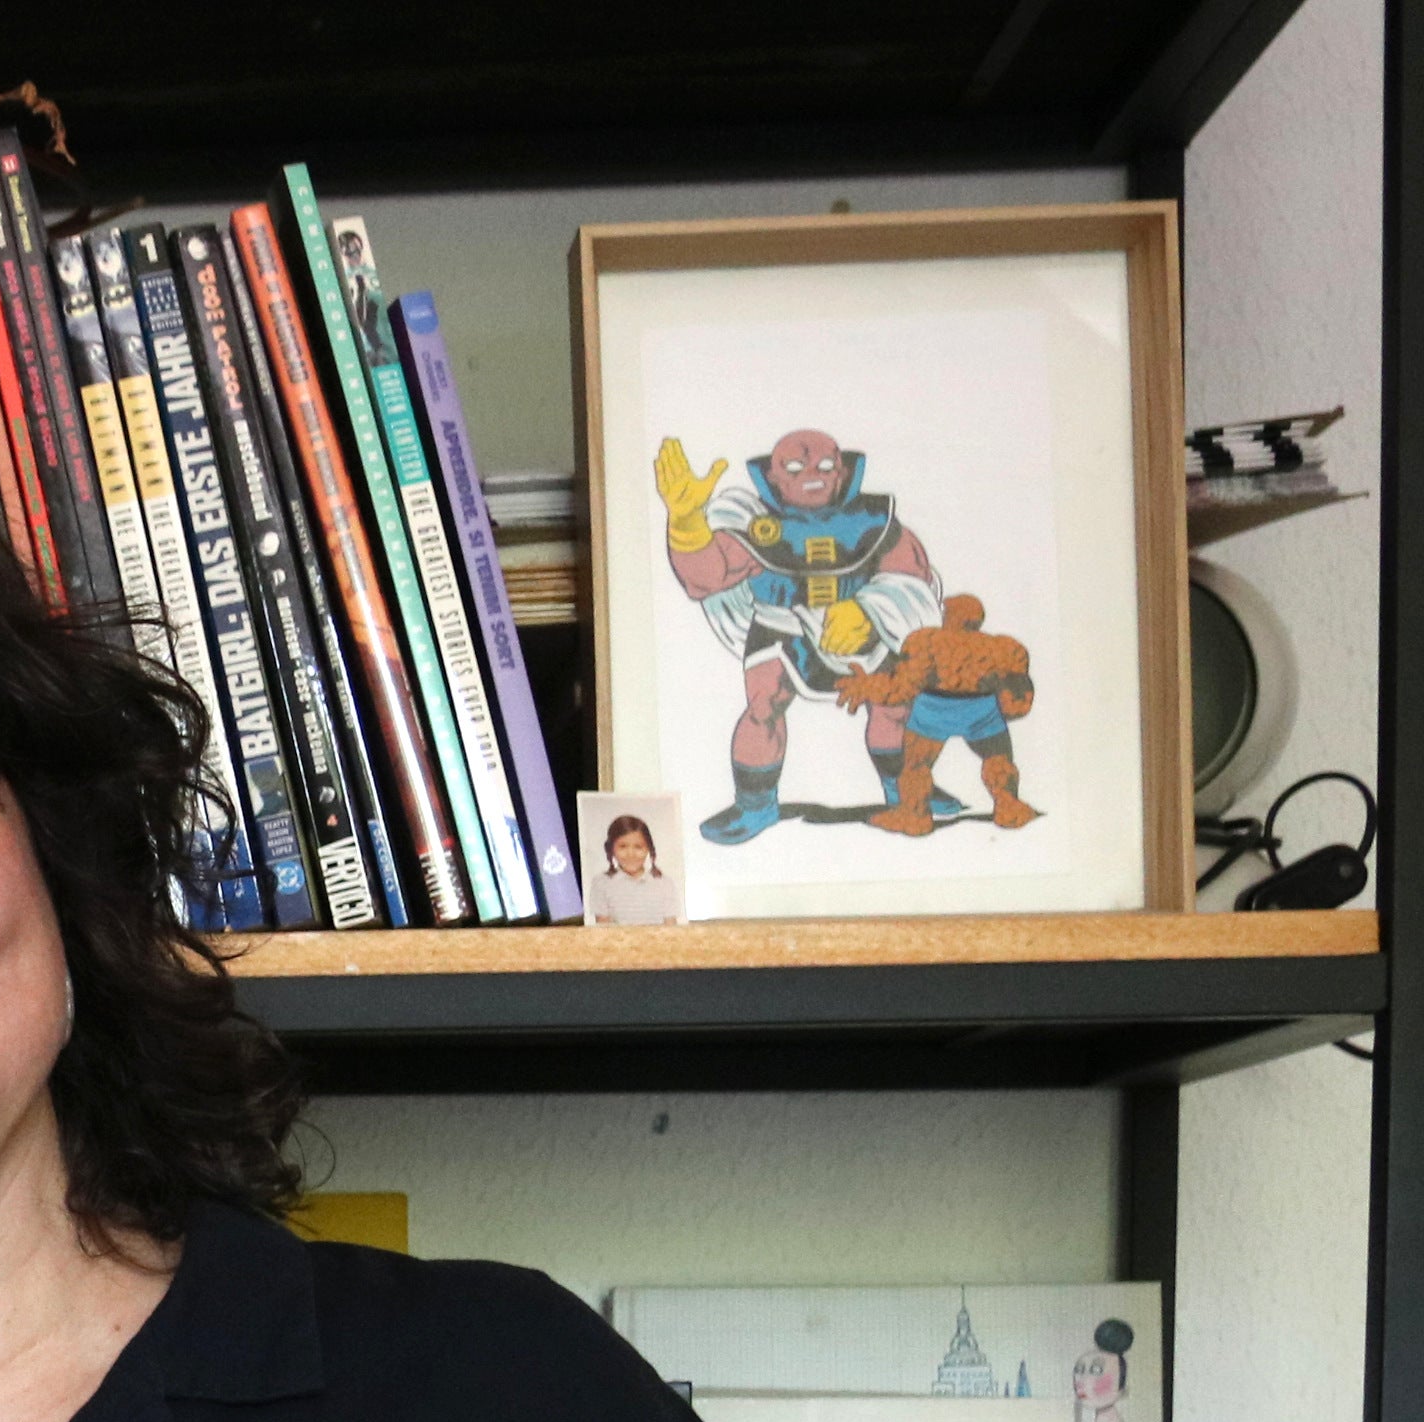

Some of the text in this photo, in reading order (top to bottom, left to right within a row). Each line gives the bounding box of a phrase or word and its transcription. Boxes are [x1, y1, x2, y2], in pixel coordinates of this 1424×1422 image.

[139, 232, 158, 263] 1
[152, 330, 205, 424] JAHR
[90, 395, 125, 494] BATMAN
[129, 386, 166, 487] BATMAN
[376, 366, 425, 481] GREEN LANTERN
[111, 507, 135, 537] THE
[174, 425, 230, 534] ERSTE
[407, 486, 432, 518] THE
[147, 500, 190, 614] THE GREATEST
[197, 537, 245, 607] DAS
[416, 523, 455, 603] GREATEST
[212, 611, 277, 759] BATGIRL:
[438, 608, 473, 678] STORIES
[489, 620, 516, 671] SORT
[315, 834, 375, 928] VERTIGO
[375, 847, 397, 894] COMICS
